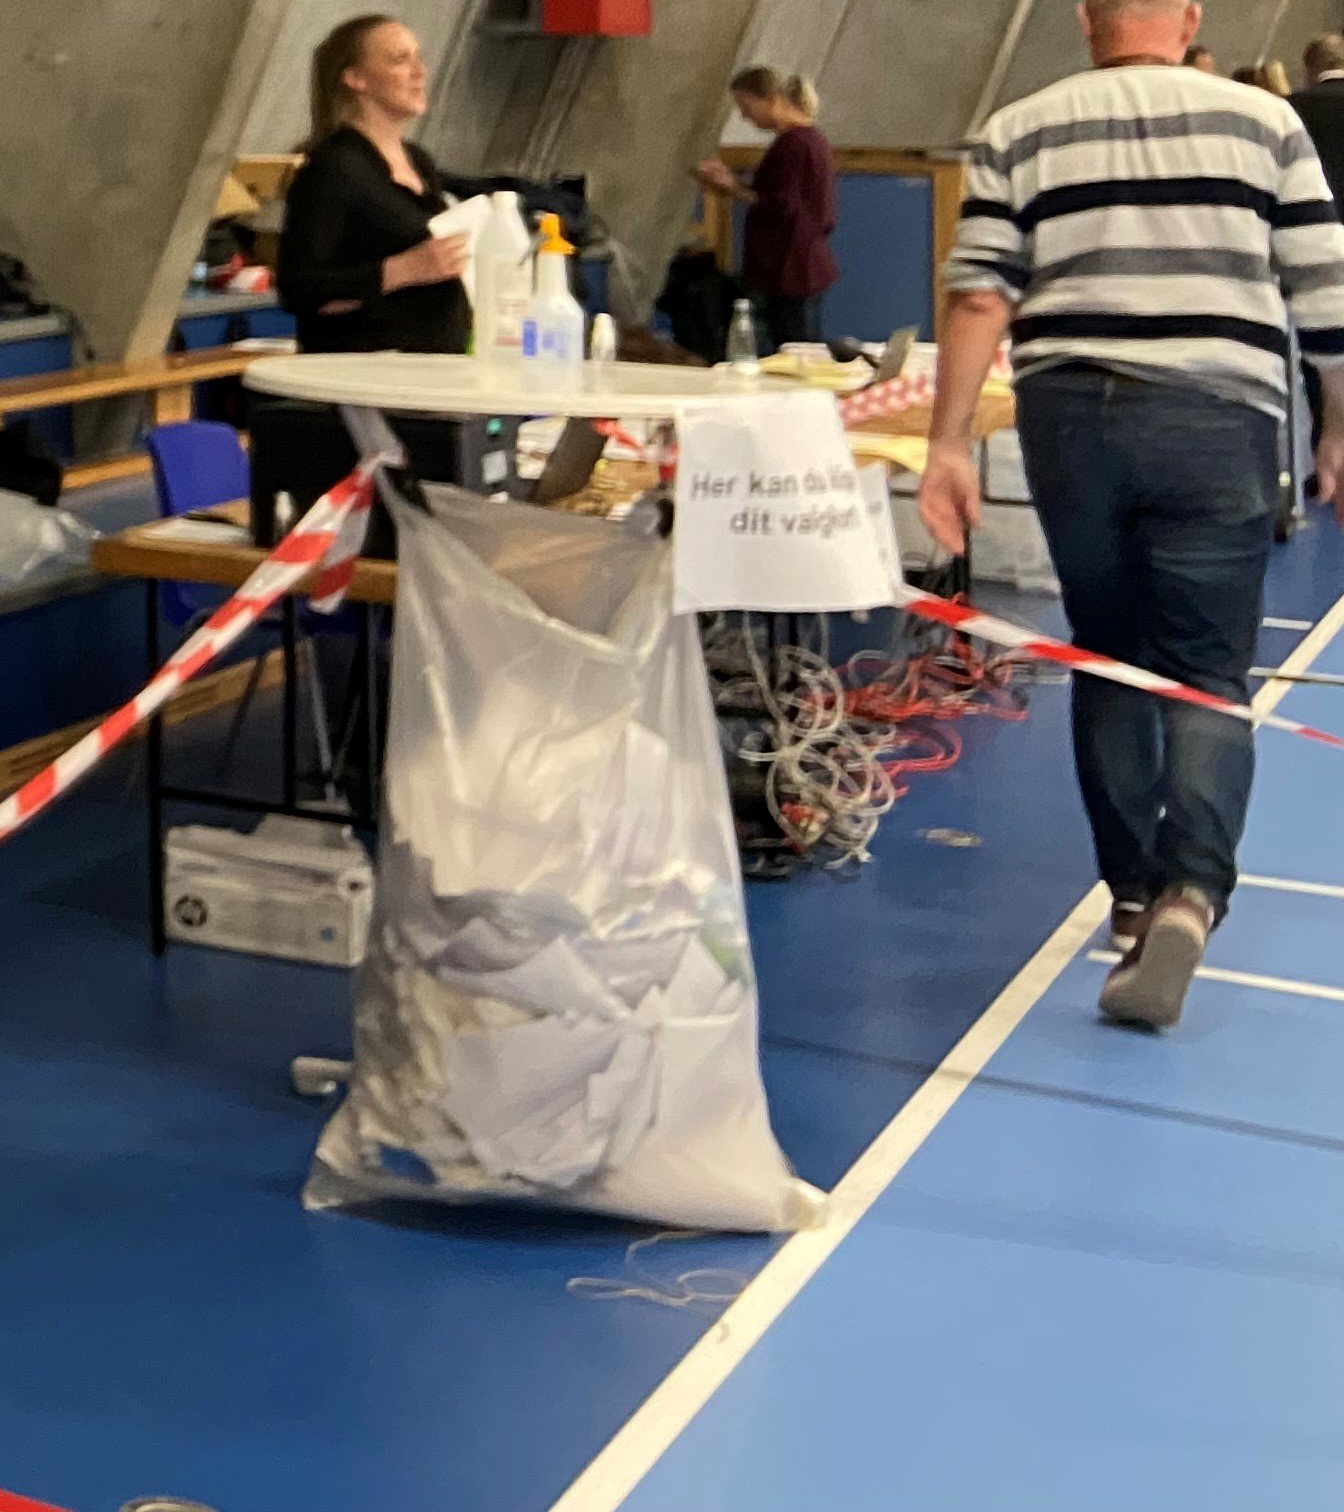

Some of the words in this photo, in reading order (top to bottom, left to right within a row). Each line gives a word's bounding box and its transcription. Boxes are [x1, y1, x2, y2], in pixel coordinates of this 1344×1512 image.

[690, 471, 738, 501] Her
[749, 467, 798, 498] kan
[729, 506, 772, 536] dit
